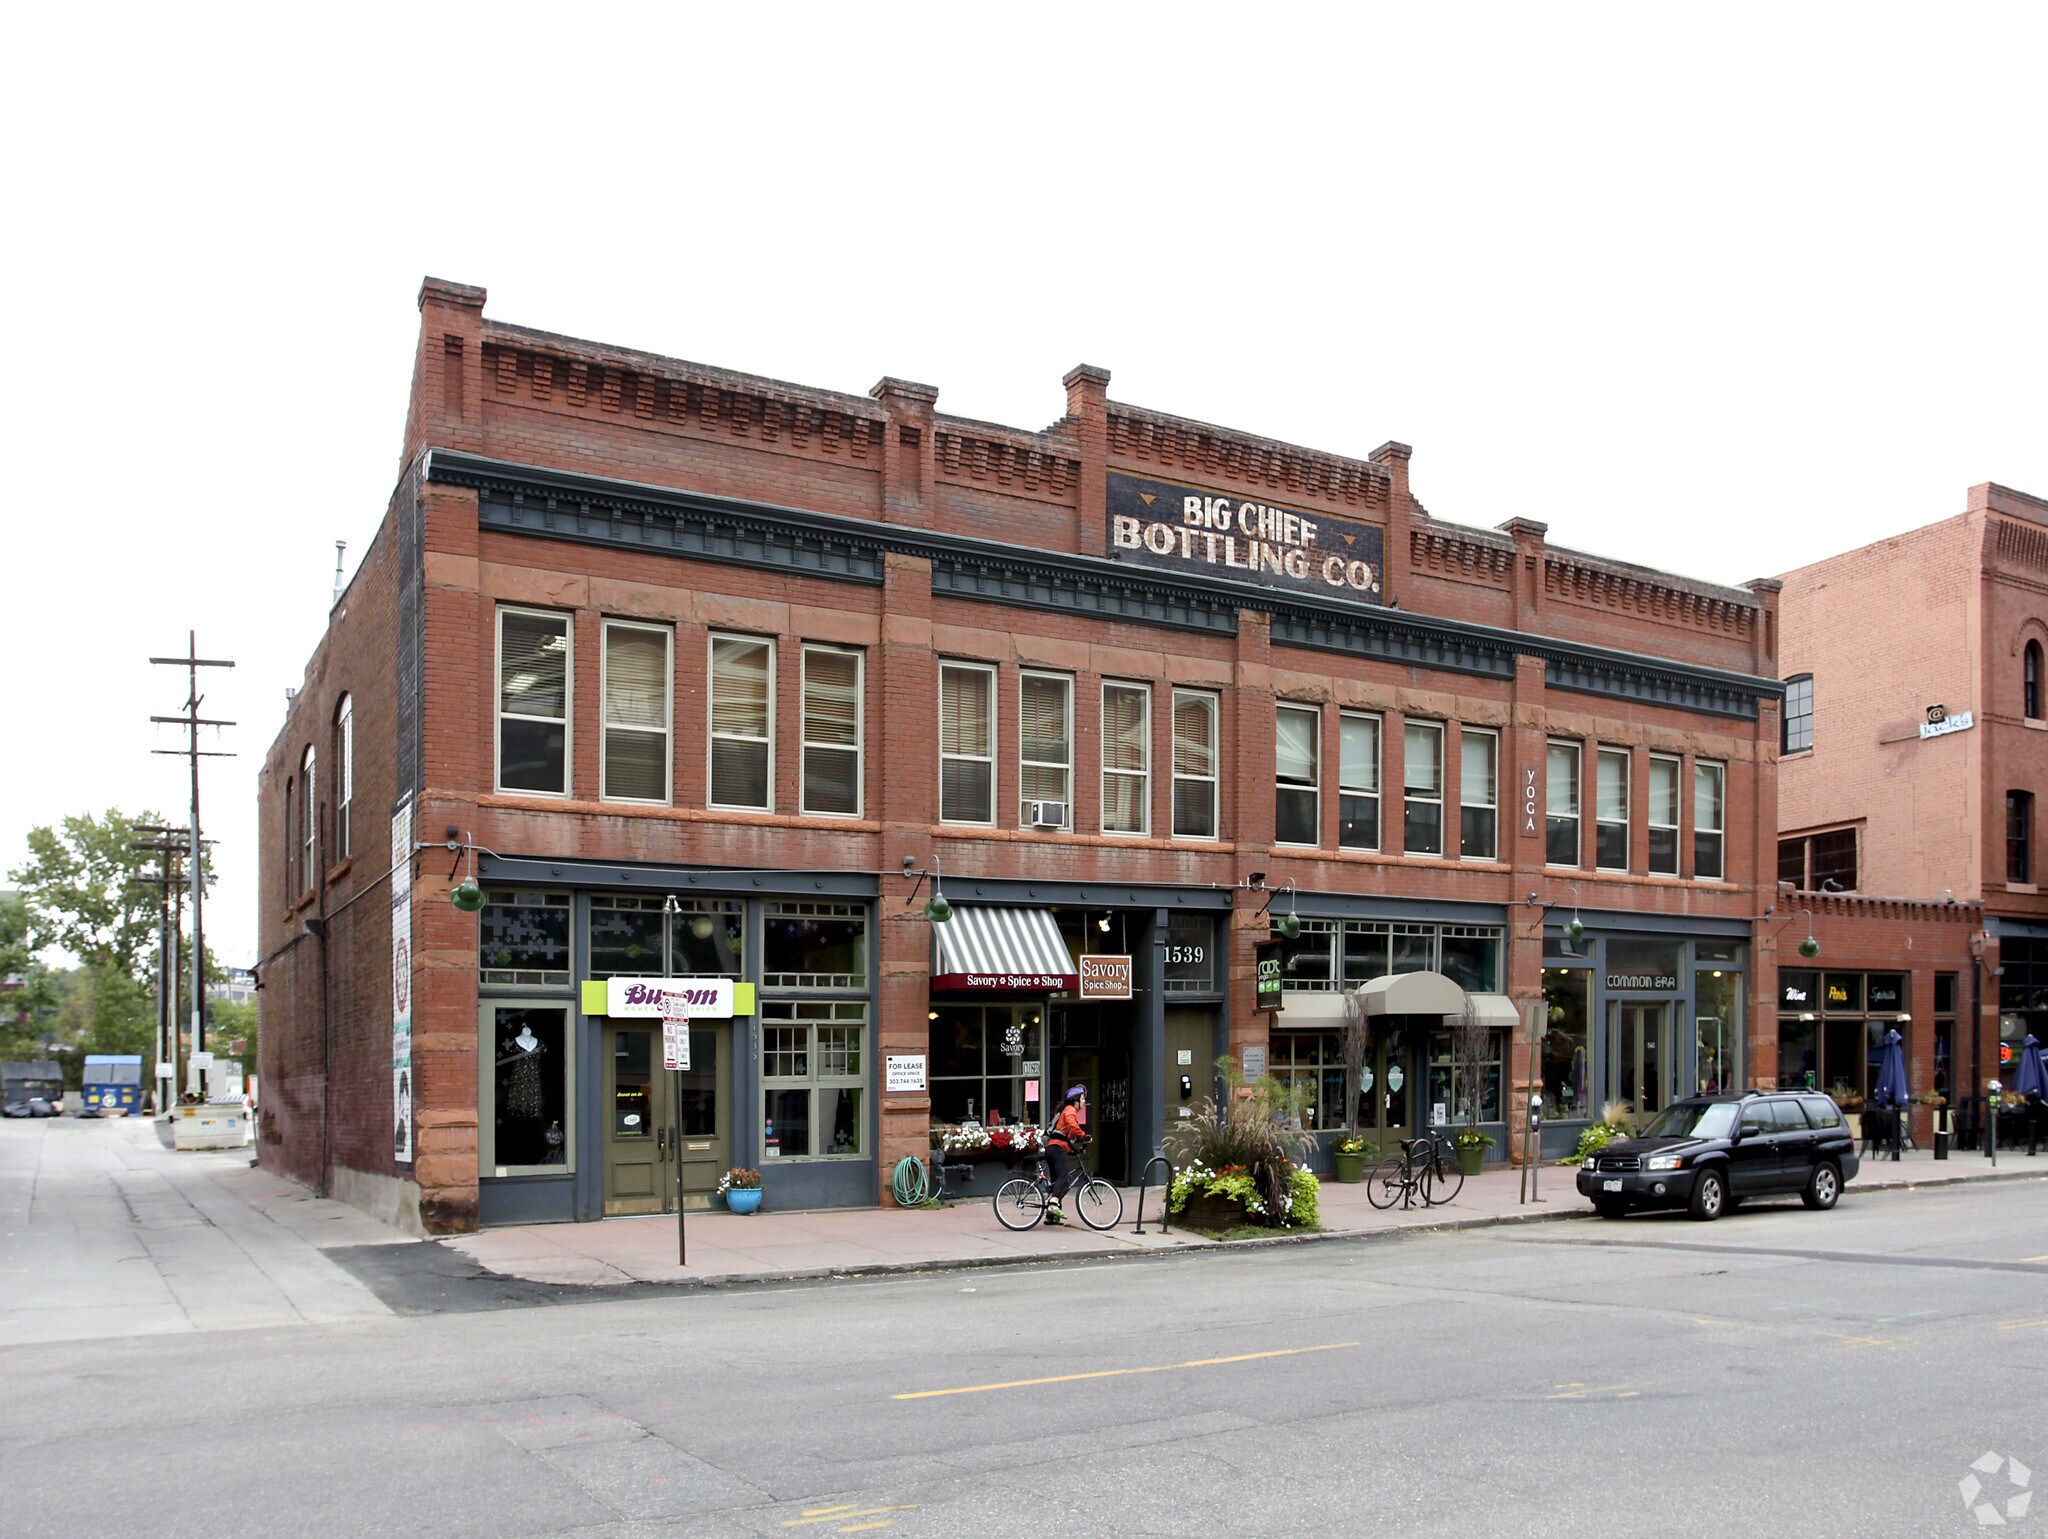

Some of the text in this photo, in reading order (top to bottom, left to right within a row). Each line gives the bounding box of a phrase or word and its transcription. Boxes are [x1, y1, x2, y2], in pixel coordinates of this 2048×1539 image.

[1183, 495, 1317, 548] BIG CHIEF
[1113, 514, 1380, 593] BOTTLING CO.
[1164, 945, 1204, 964] 1539
[1083, 959, 1129, 980] Savory
[967, 974, 1063, 989] Savory Spice Shop
[1084, 980, 1104, 991] Spice
[1105, 980, 1123, 990] Shop
[1655, 976, 1675, 988] ERA
[624, 983, 718, 1011] Buom
[1786, 986, 1807, 1001] Wine
[1000, 1042, 1025, 1054] Savory
[904, 1062, 923, 1070] LEASE
